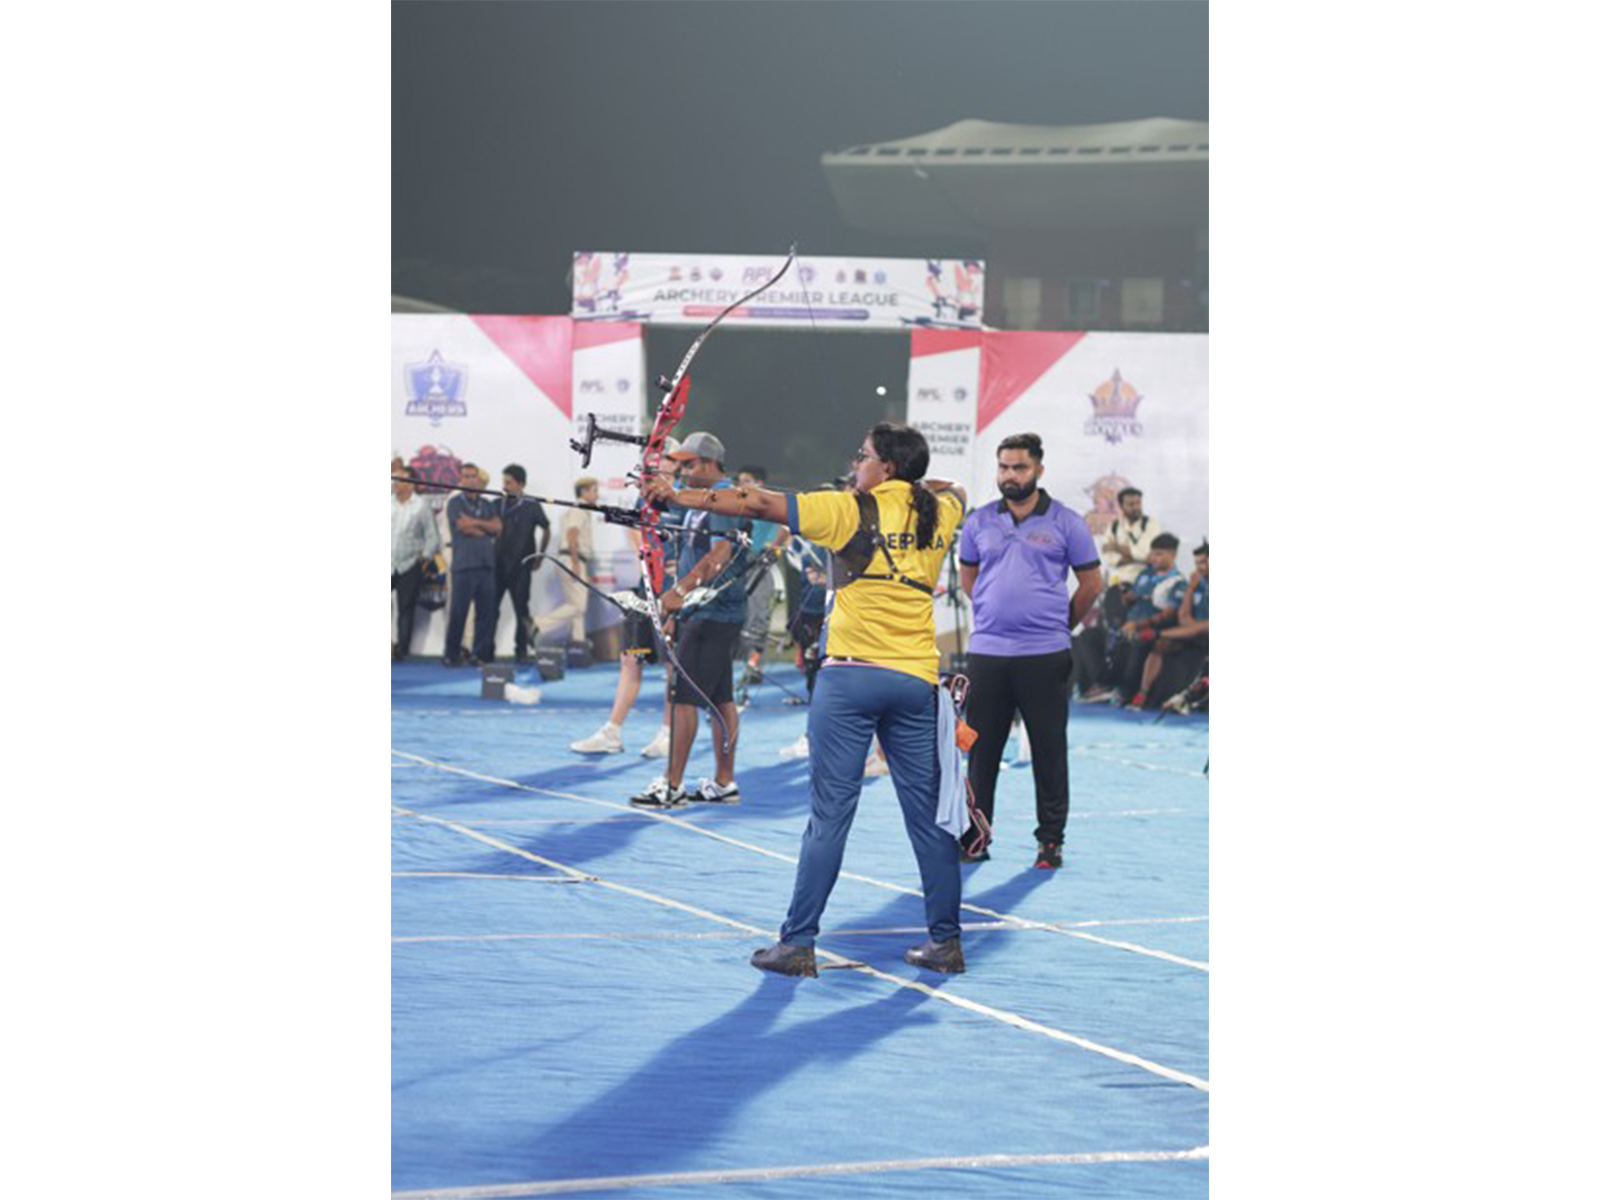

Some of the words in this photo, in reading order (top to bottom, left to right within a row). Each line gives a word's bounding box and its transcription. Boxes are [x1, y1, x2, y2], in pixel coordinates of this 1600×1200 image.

[654, 288, 738, 302] ARCHERY
[829, 292, 899, 306] LEAGUE
[577, 413, 636, 424] ACHERY
[931, 445, 965, 456] AGUE
[877, 532, 943, 550] EEPA
